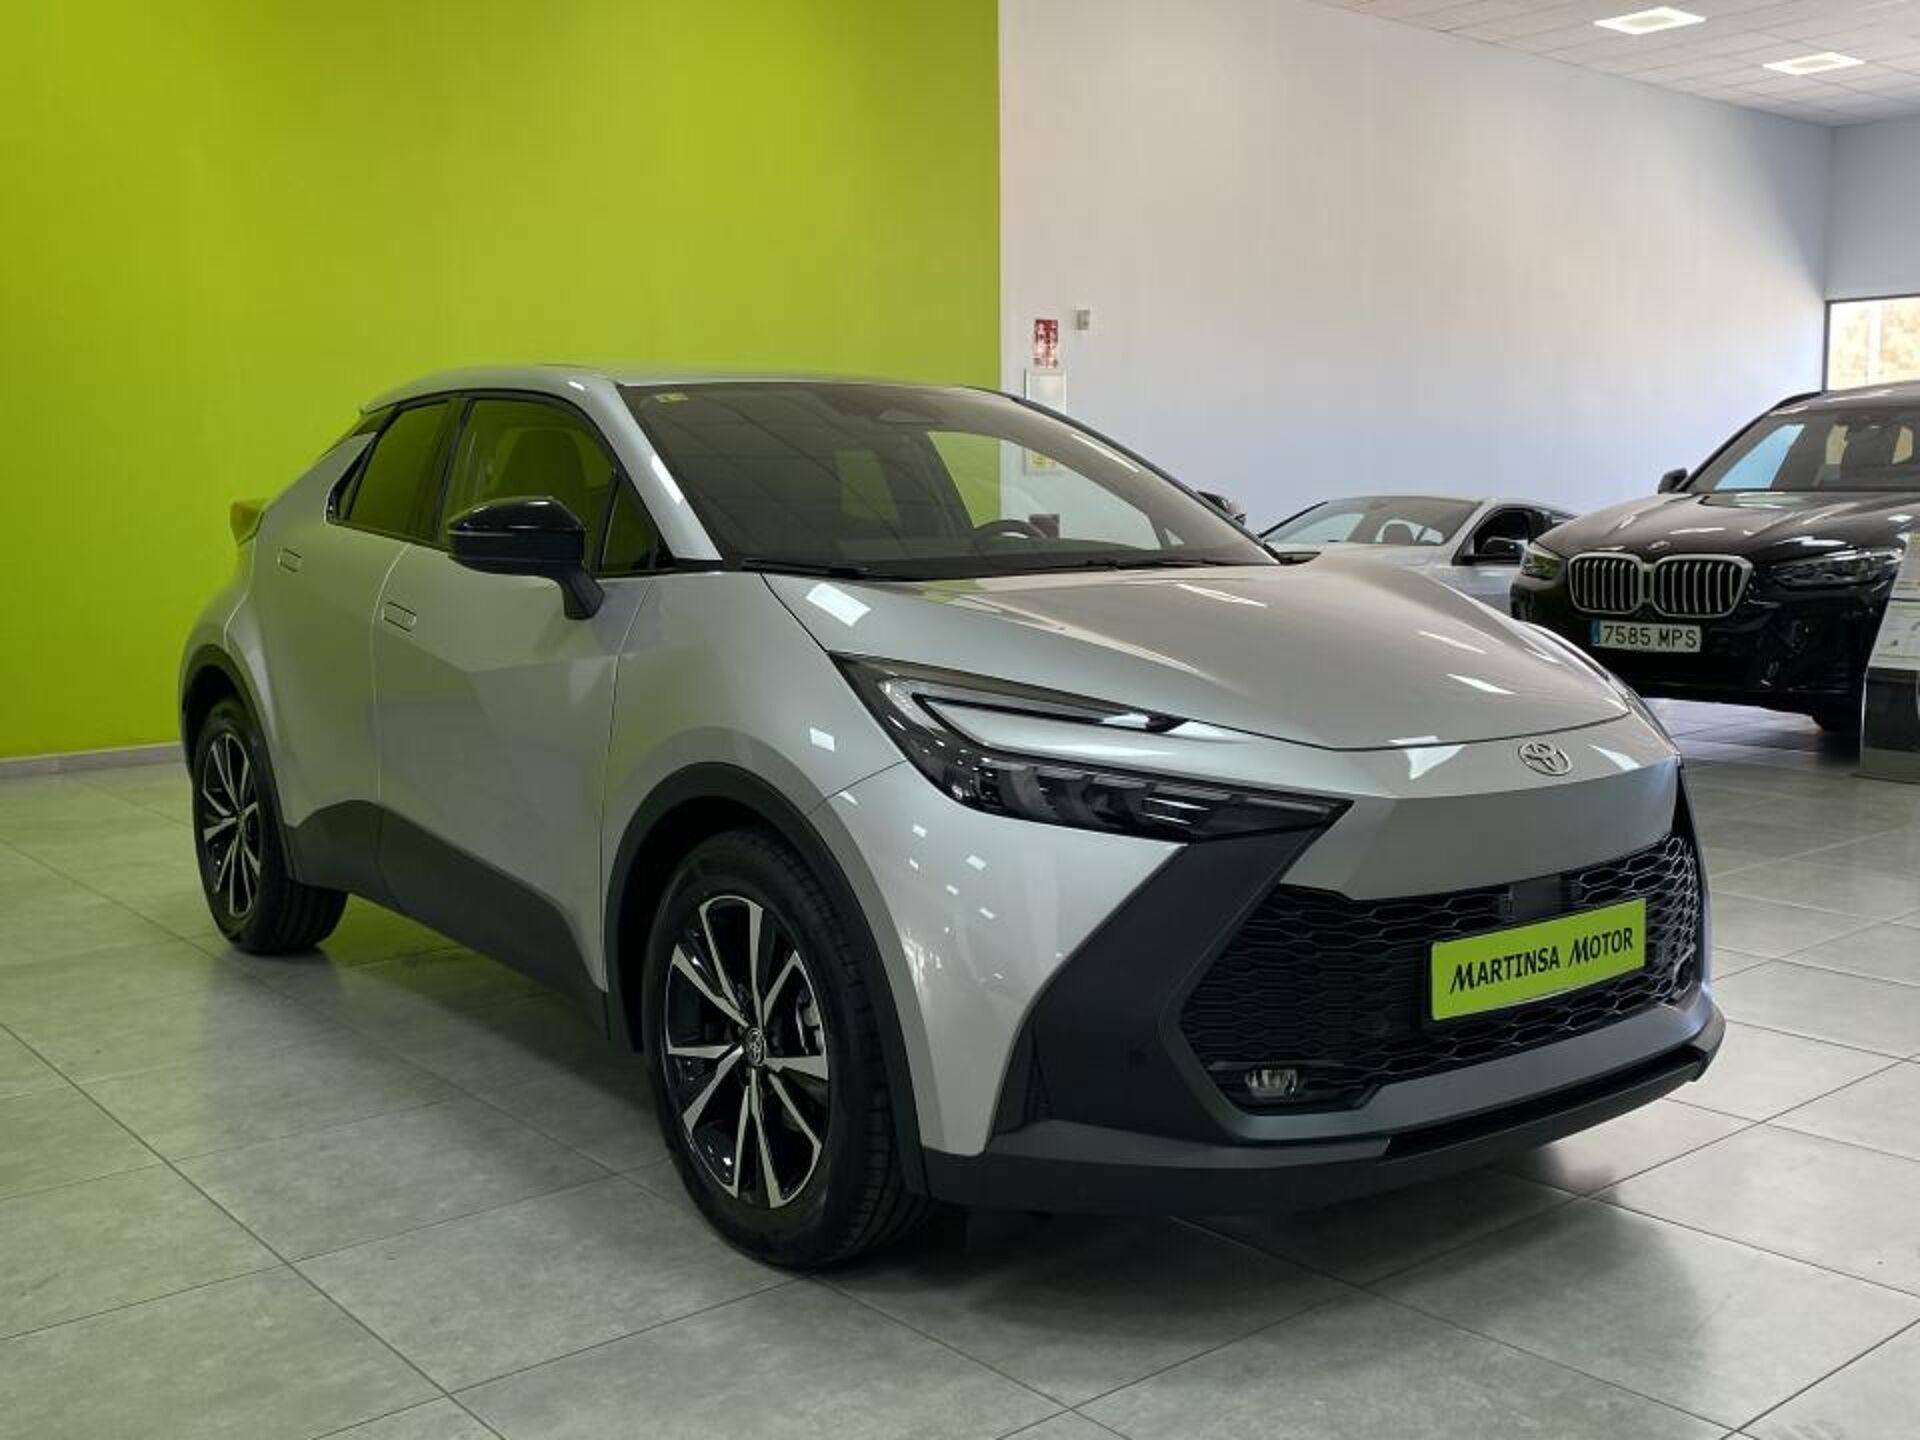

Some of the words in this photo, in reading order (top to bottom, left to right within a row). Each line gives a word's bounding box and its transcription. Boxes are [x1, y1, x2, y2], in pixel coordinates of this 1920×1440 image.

[1604, 625, 1650, 646] 7585
[1658, 628, 1697, 648] MPS
[1450, 945, 1560, 994] MARTINSA
[1568, 927, 1633, 967] MOTOR
